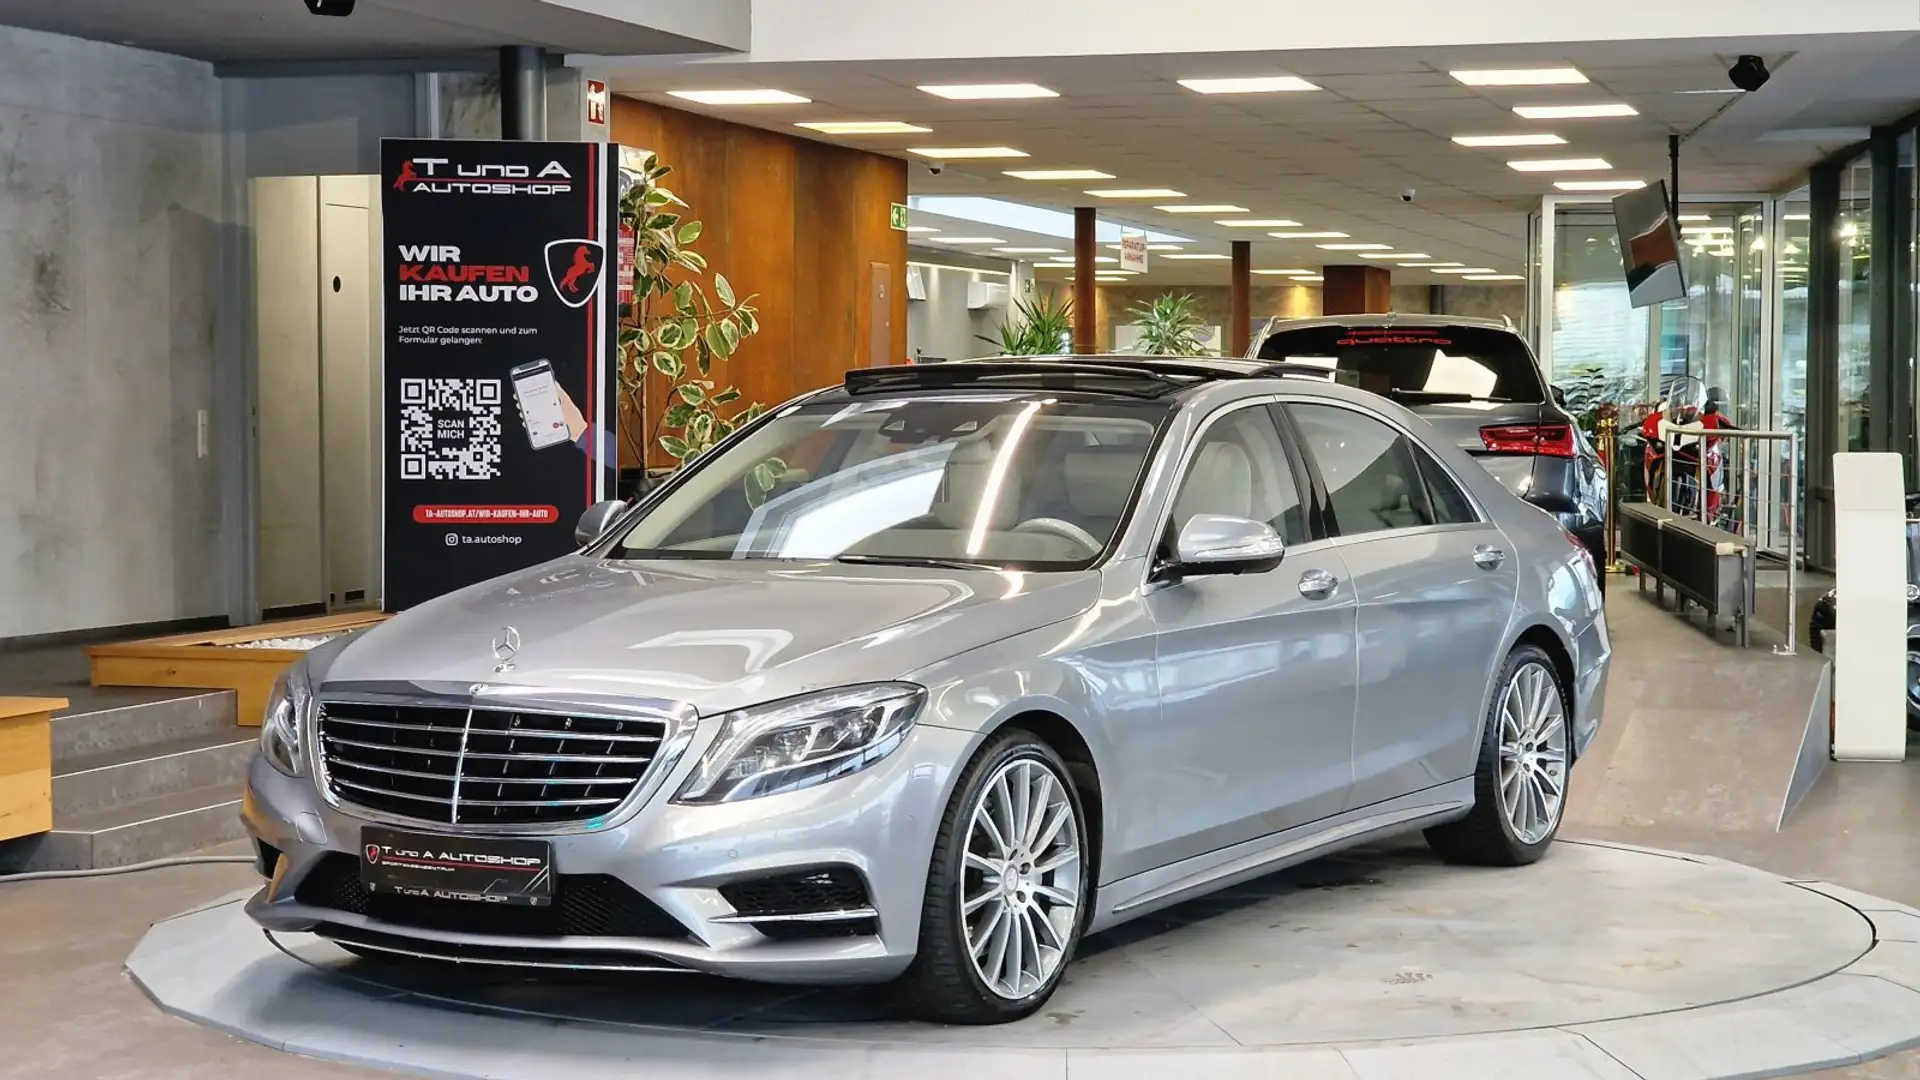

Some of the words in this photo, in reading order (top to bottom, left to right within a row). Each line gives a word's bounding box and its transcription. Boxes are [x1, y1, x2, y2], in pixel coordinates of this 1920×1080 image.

[413, 158, 448, 175] T
[537, 160, 572, 178] A
[413, 182, 571, 195] AUTOSHOP
[398, 244, 461, 263] WIR
[399, 264, 529, 282] KAUFEN
[399, 284, 452, 302] IHR
[455, 285, 539, 302] AUTO
[398, 326, 420, 334] Jetzt
[421, 326, 436, 334] QR
[437, 326, 459, 334] Code
[398, 336, 438, 344] Formular
[437, 419, 464, 429] SCAN
[437, 429, 464, 439] MICH
[462, 534, 522, 545] ta.autoshop
[381, 846, 392, 854] T
[423, 849, 435, 859] A
[438, 851, 542, 866] AUTOSHOP
[394, 886, 403, 894] T
[433, 891, 508, 902] AUTOSHOP
